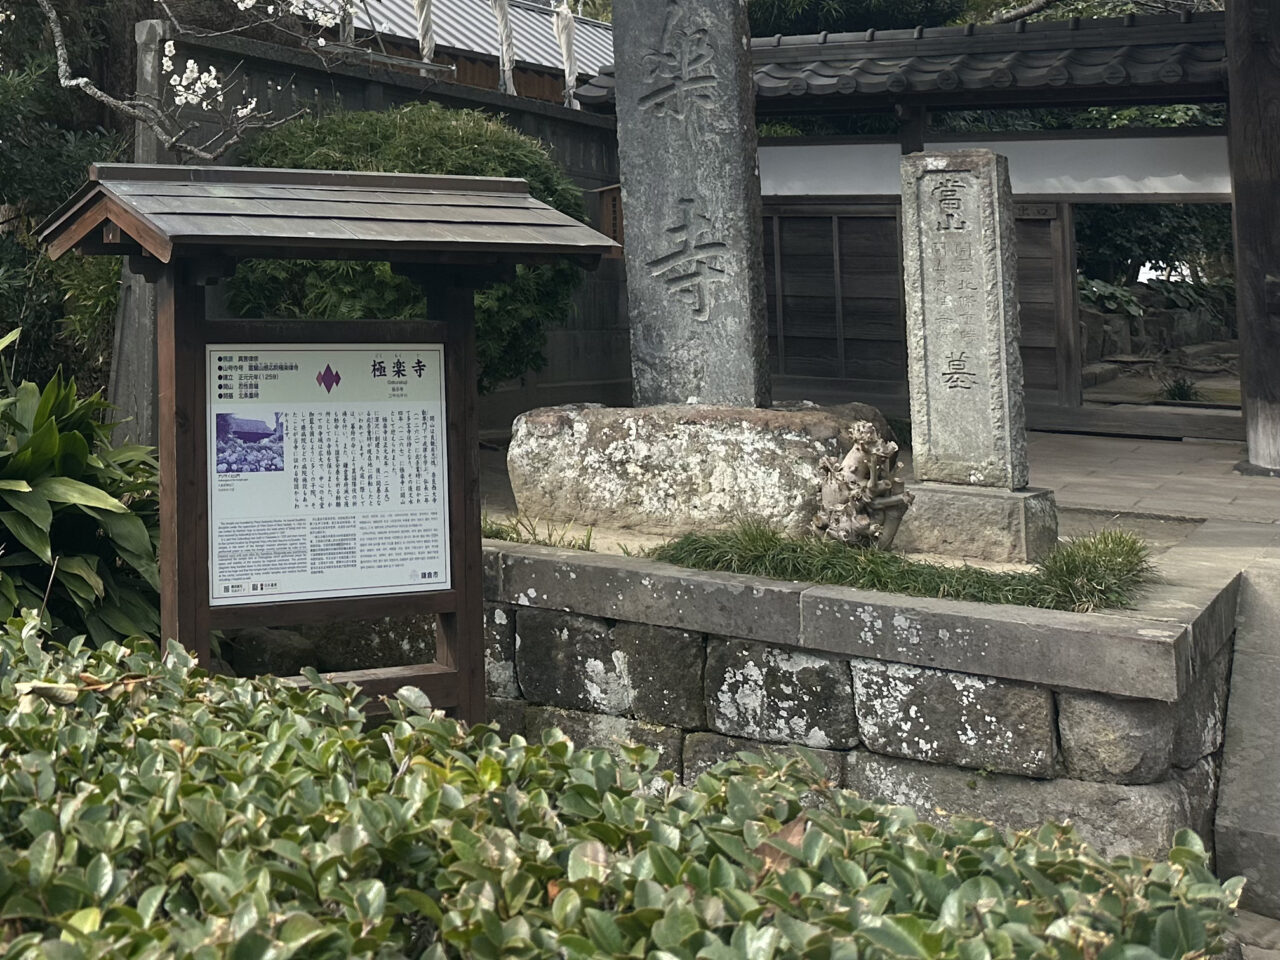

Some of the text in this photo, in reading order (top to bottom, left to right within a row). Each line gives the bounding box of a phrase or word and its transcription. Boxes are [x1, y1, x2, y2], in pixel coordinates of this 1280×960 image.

[371, 359, 426, 378] 極楽寺
[942, 352, 978, 389] 墓
